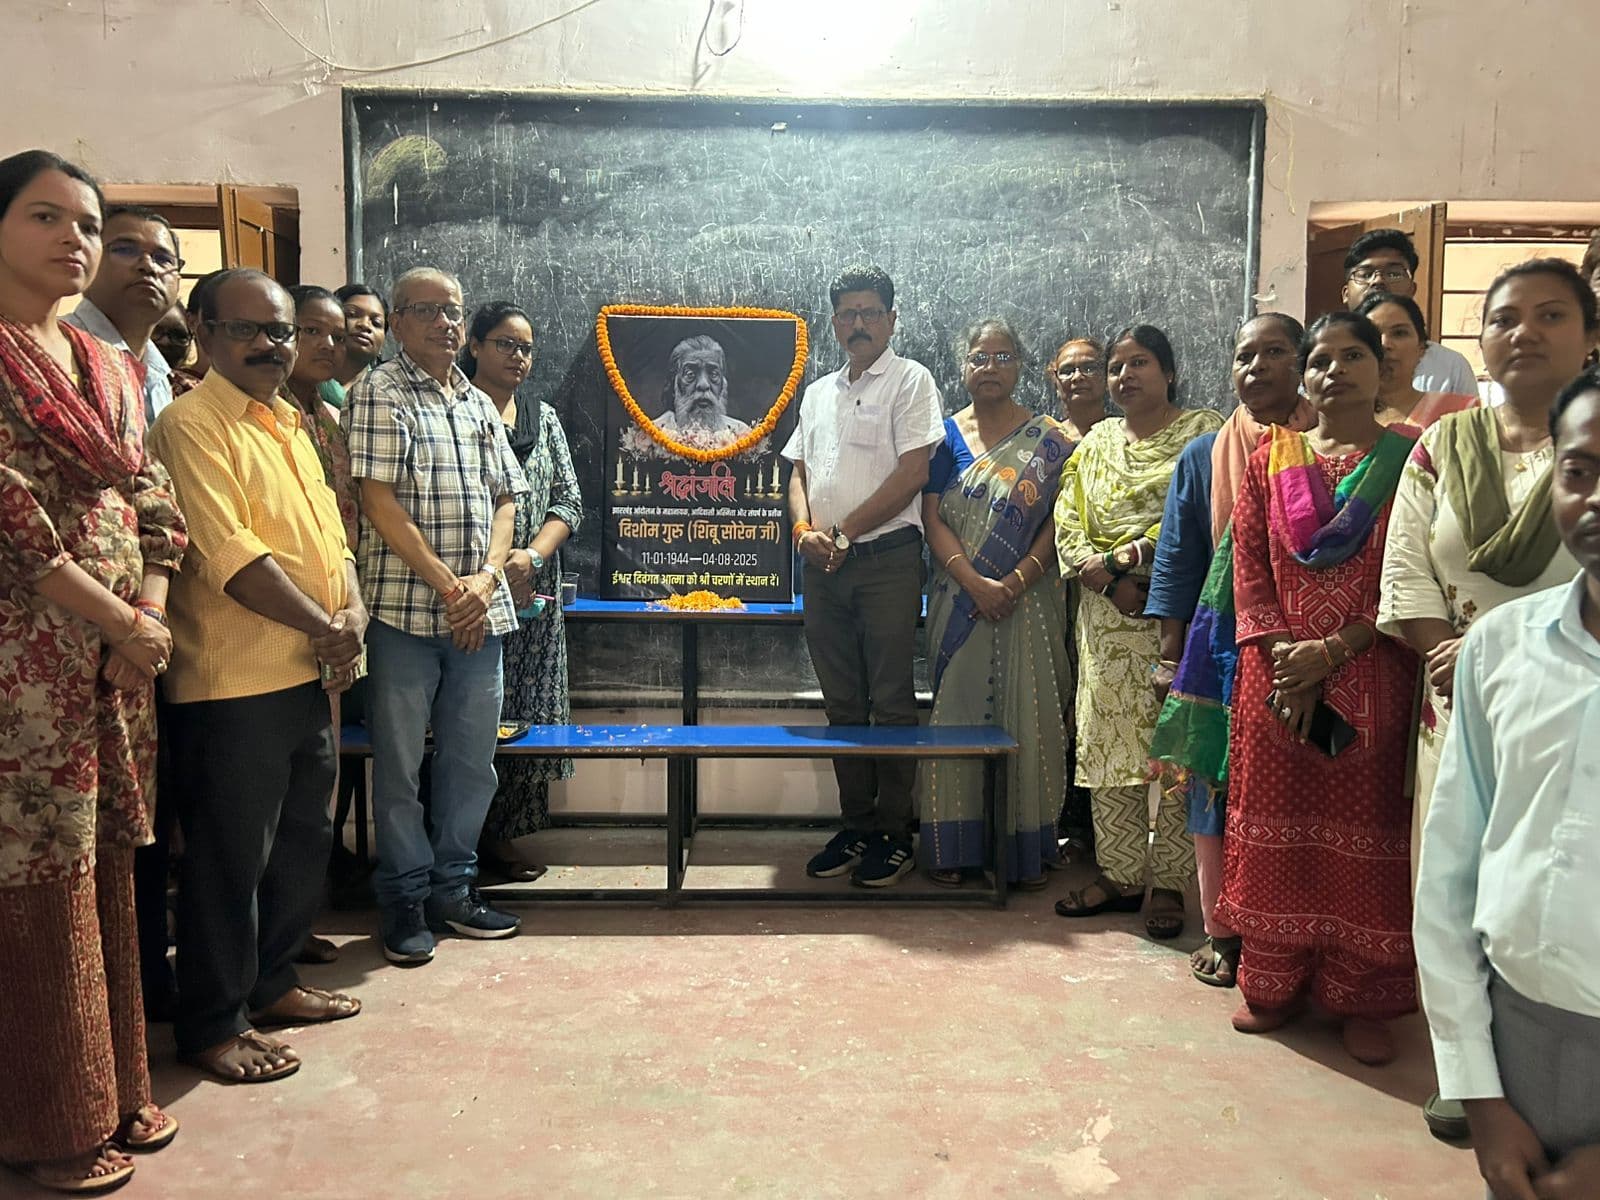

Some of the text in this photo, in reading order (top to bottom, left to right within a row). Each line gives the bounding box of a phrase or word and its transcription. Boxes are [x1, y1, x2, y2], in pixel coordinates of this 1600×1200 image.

[658, 461, 738, 502] श्रद्धांजलि
[656, 506, 662, 515] के
[761, 508, 767, 517] के
[618, 518, 781, 545] दिशोम गुरु (शिबू सोरेन जी)
[612, 570, 631, 585] ईश्वर
[633, 570, 659, 585] दिवंगत
[661, 572, 685, 585] आत्मा
[686, 572, 697, 585] को
[699, 572, 710, 585] श्री
[711, 572, 735, 586] चरणों
[735, 572, 745, 586] में
[745, 574, 768, 586] स्थान
